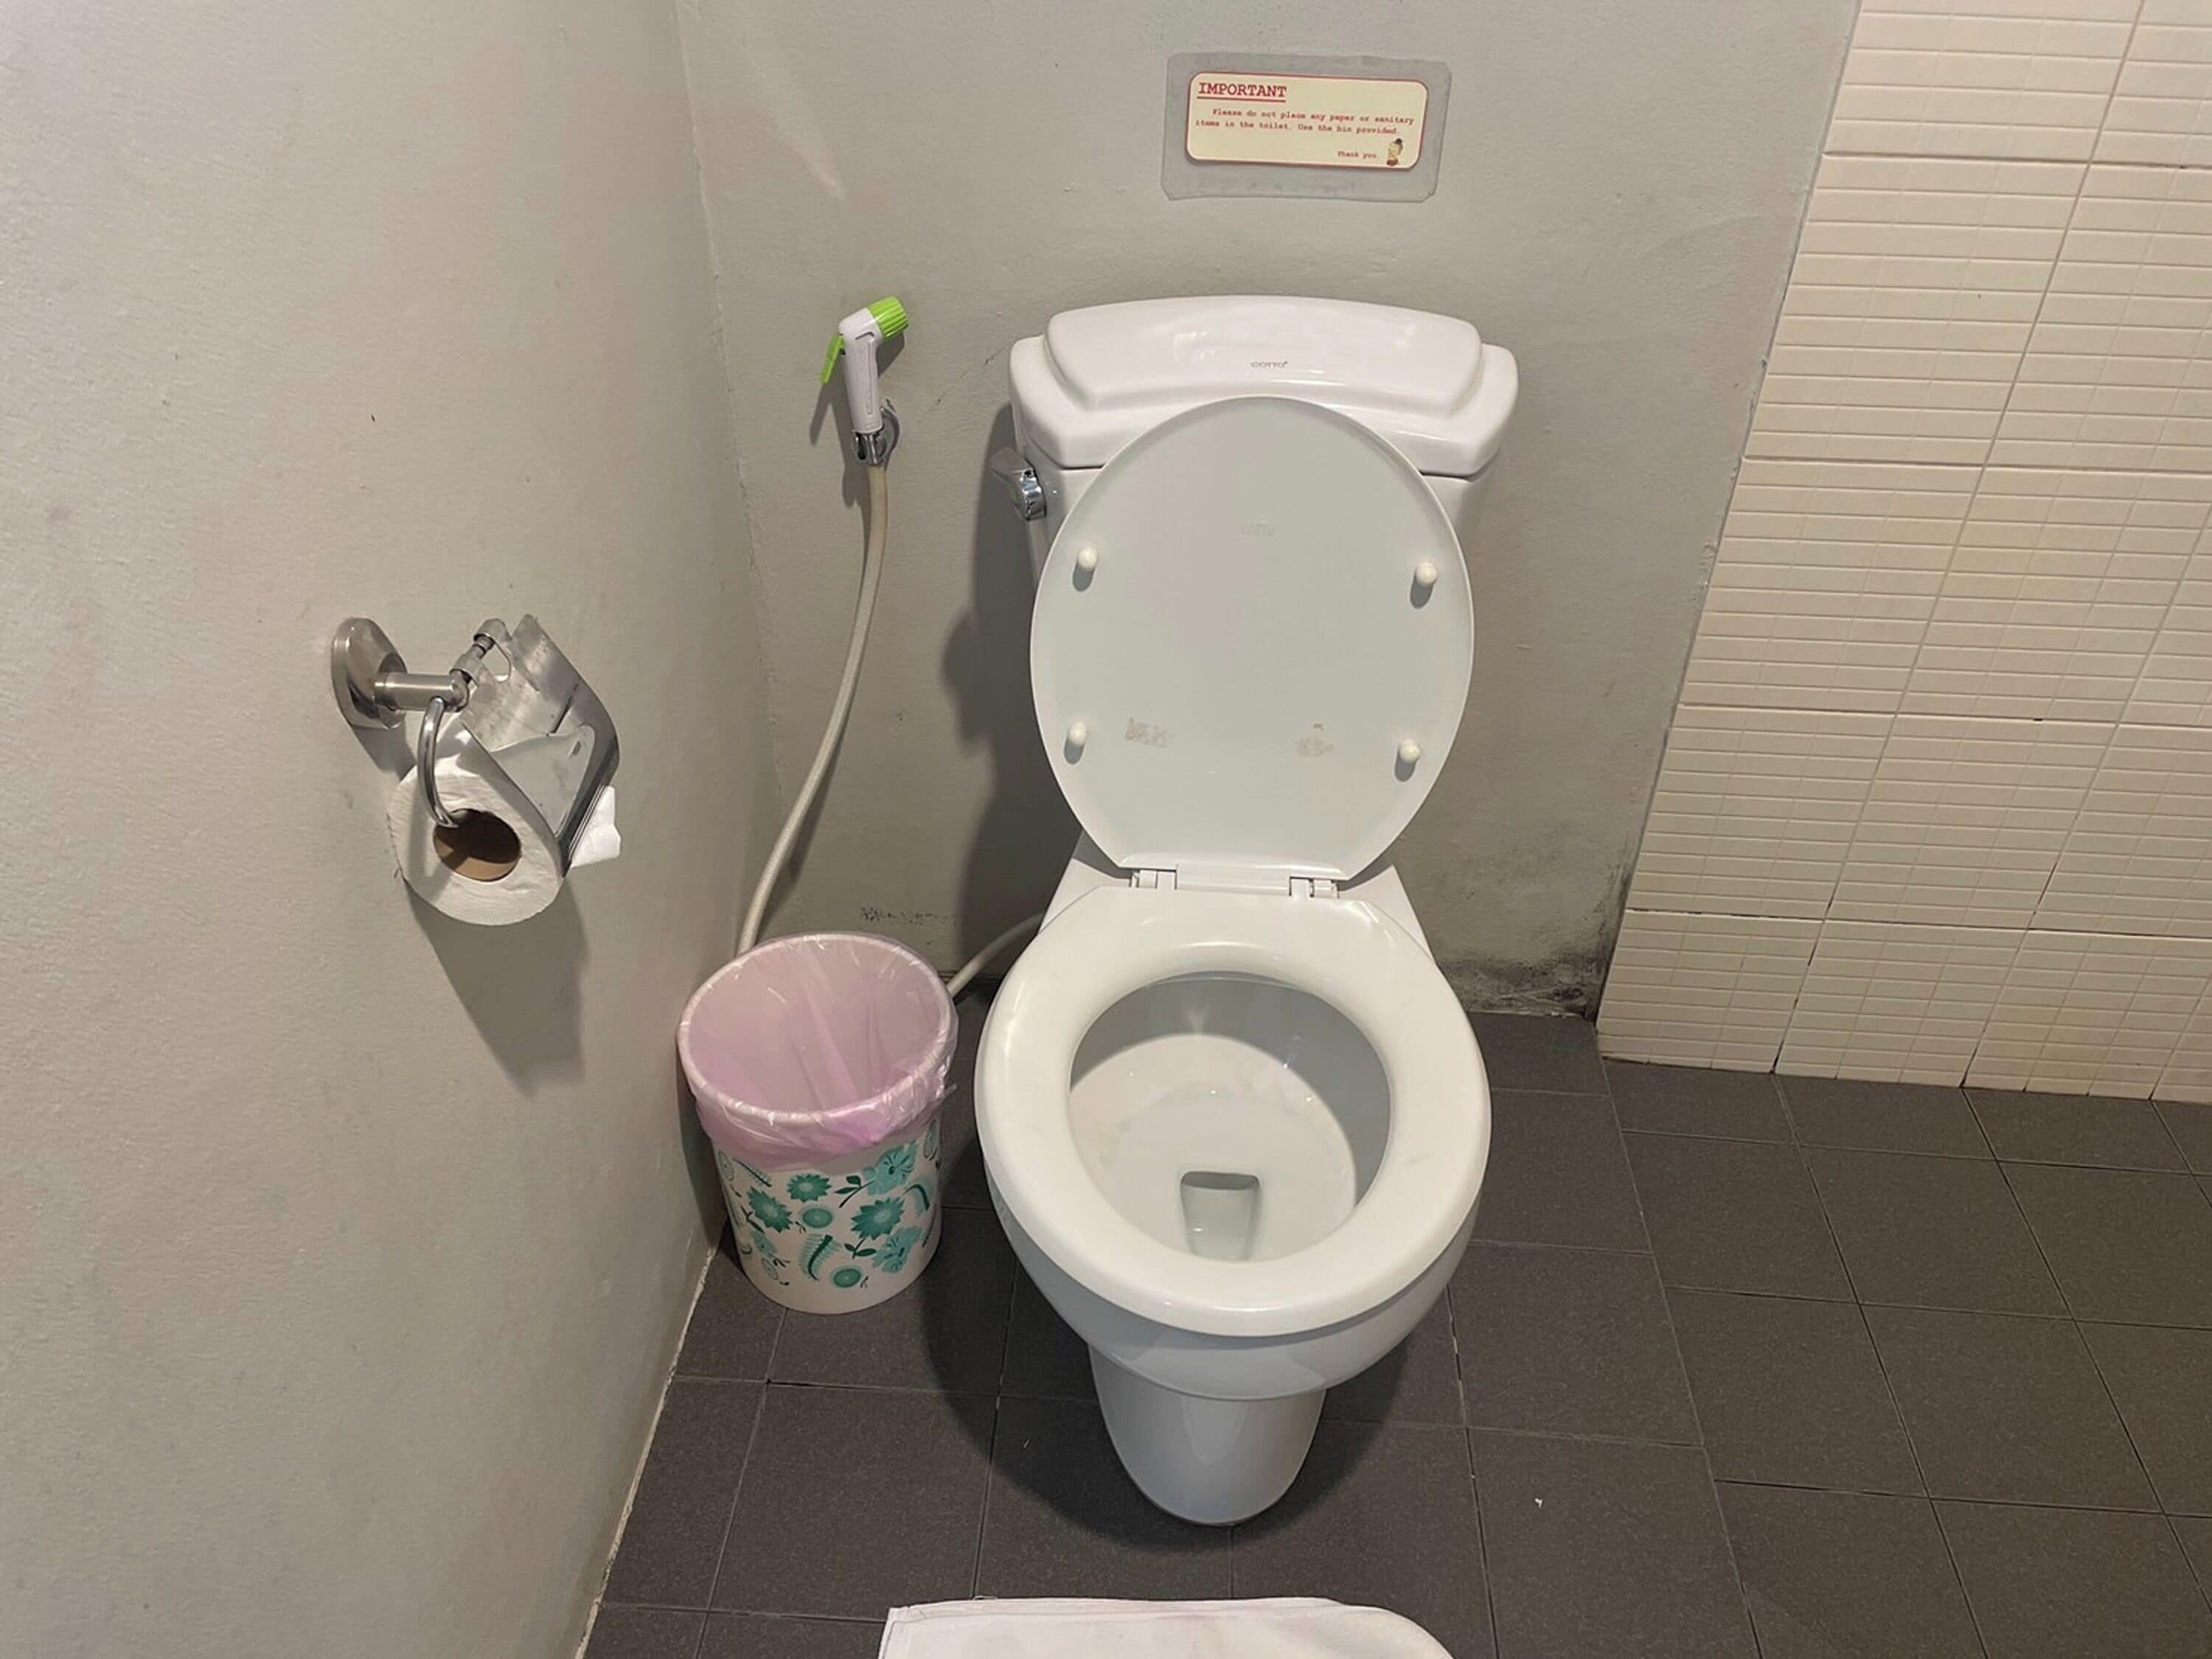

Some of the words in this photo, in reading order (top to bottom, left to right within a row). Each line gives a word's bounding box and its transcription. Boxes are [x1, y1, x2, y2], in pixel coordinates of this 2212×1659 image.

[1198, 82, 1287, 97] IMPORTANT
[1213, 108, 1242, 116] Please
[1281, 111, 1306, 120] place
[1311, 114, 1326, 122] any
[1330, 114, 1354, 122] paper
[1374, 115, 1414, 125] sanitary
[1239, 120, 1254, 128] the
[1259, 122, 1291, 130] toilet.
